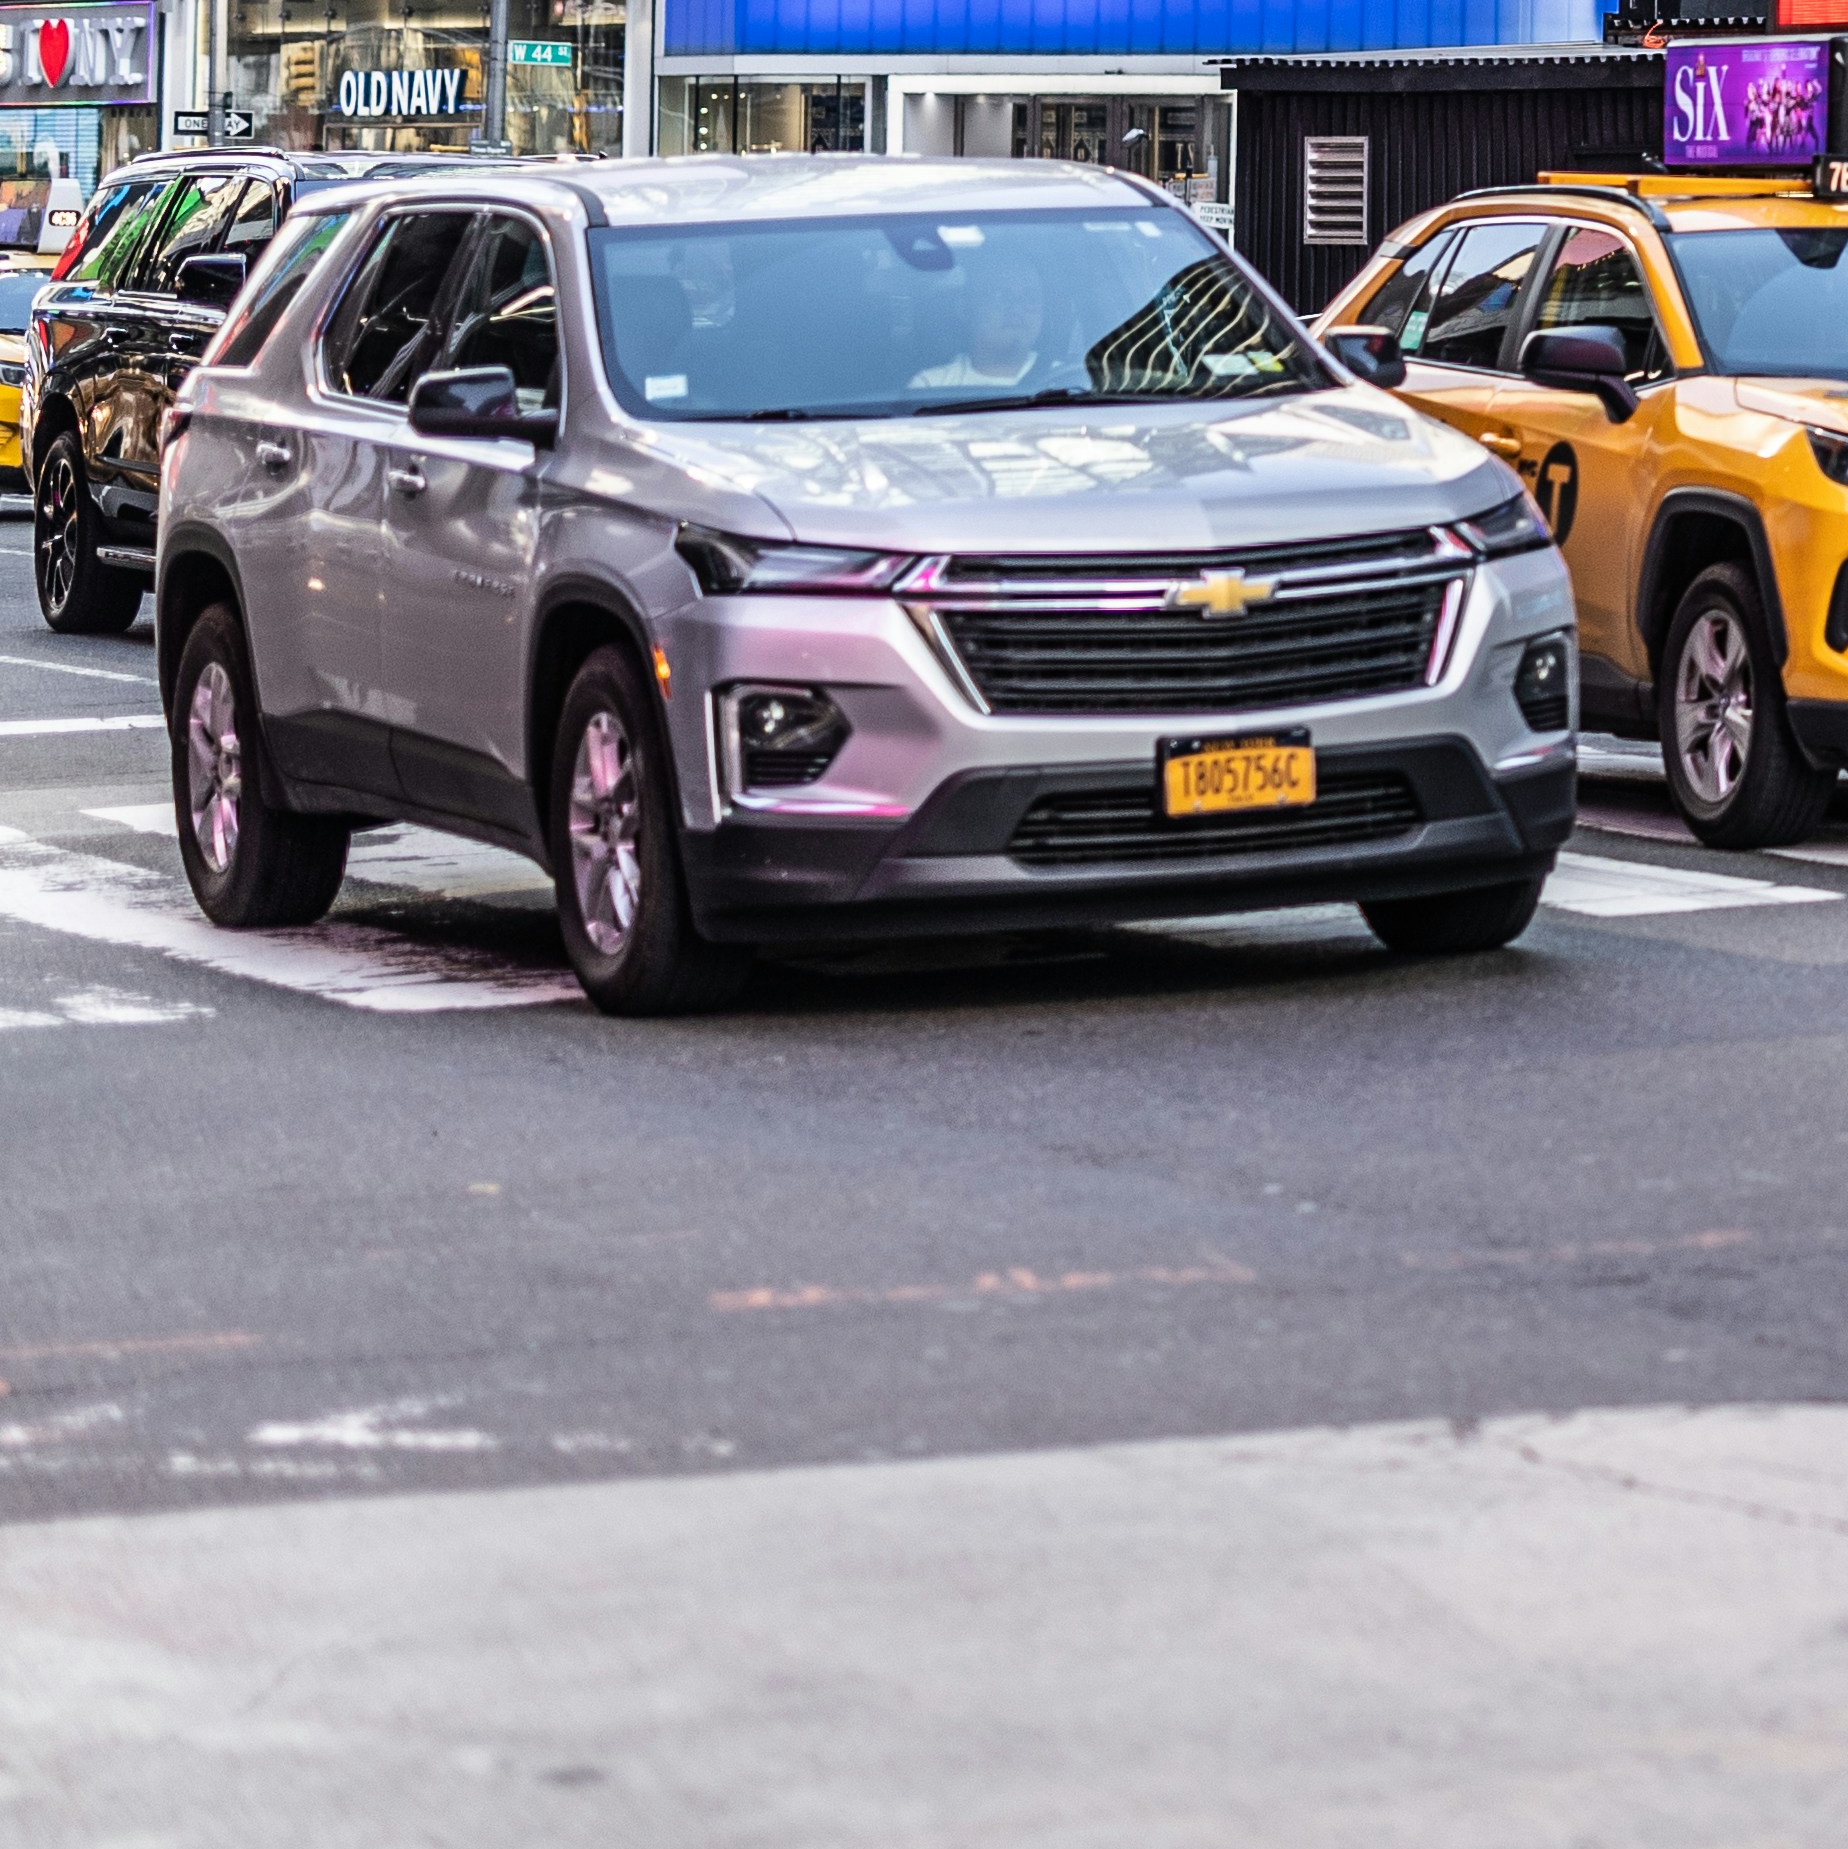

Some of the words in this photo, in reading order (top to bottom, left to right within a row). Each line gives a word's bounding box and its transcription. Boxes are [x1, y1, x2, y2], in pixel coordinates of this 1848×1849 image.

[514, 45, 527, 62] W
[531, 44, 553, 62] 44
[340, 70, 387, 117] OLD
[391, 68, 461, 115] NAVY
[184, 118, 207, 129] ONE
